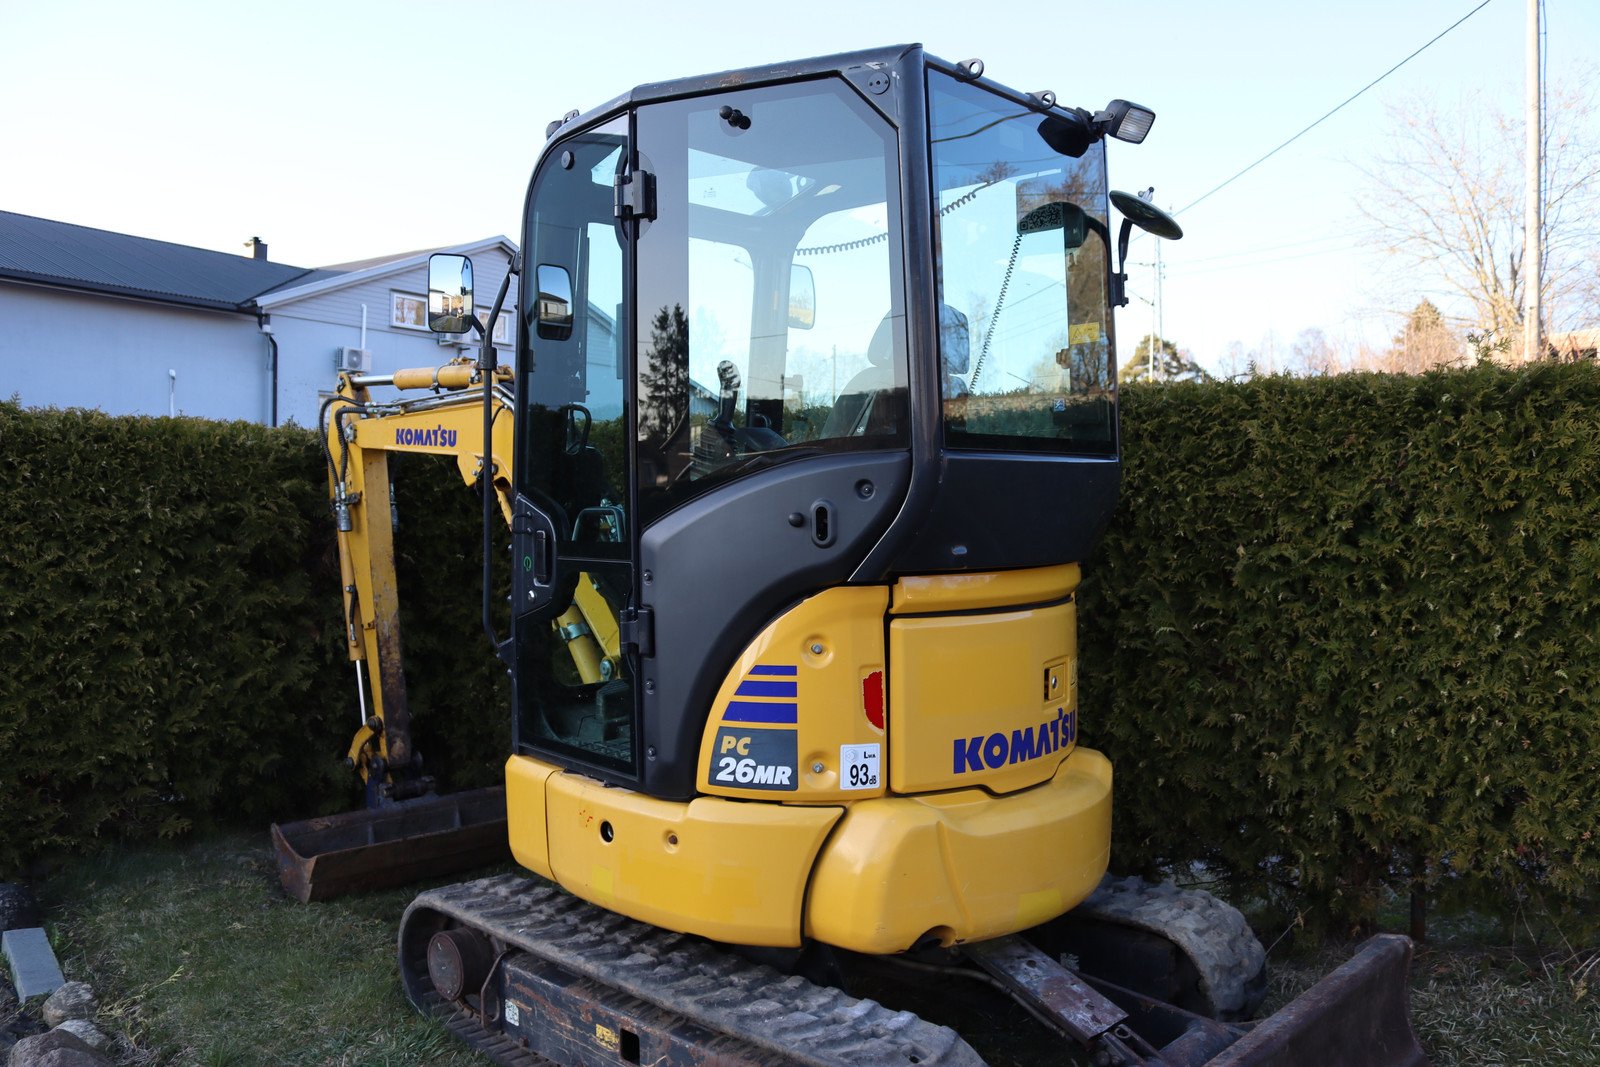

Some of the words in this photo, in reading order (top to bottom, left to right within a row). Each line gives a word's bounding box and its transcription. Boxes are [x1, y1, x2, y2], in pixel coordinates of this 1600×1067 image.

[396, 424, 457, 447] KOMATSU
[720, 735, 751, 756] PC
[953, 707, 1076, 774] KOMATSU
[716, 756, 792, 785] 26MR
